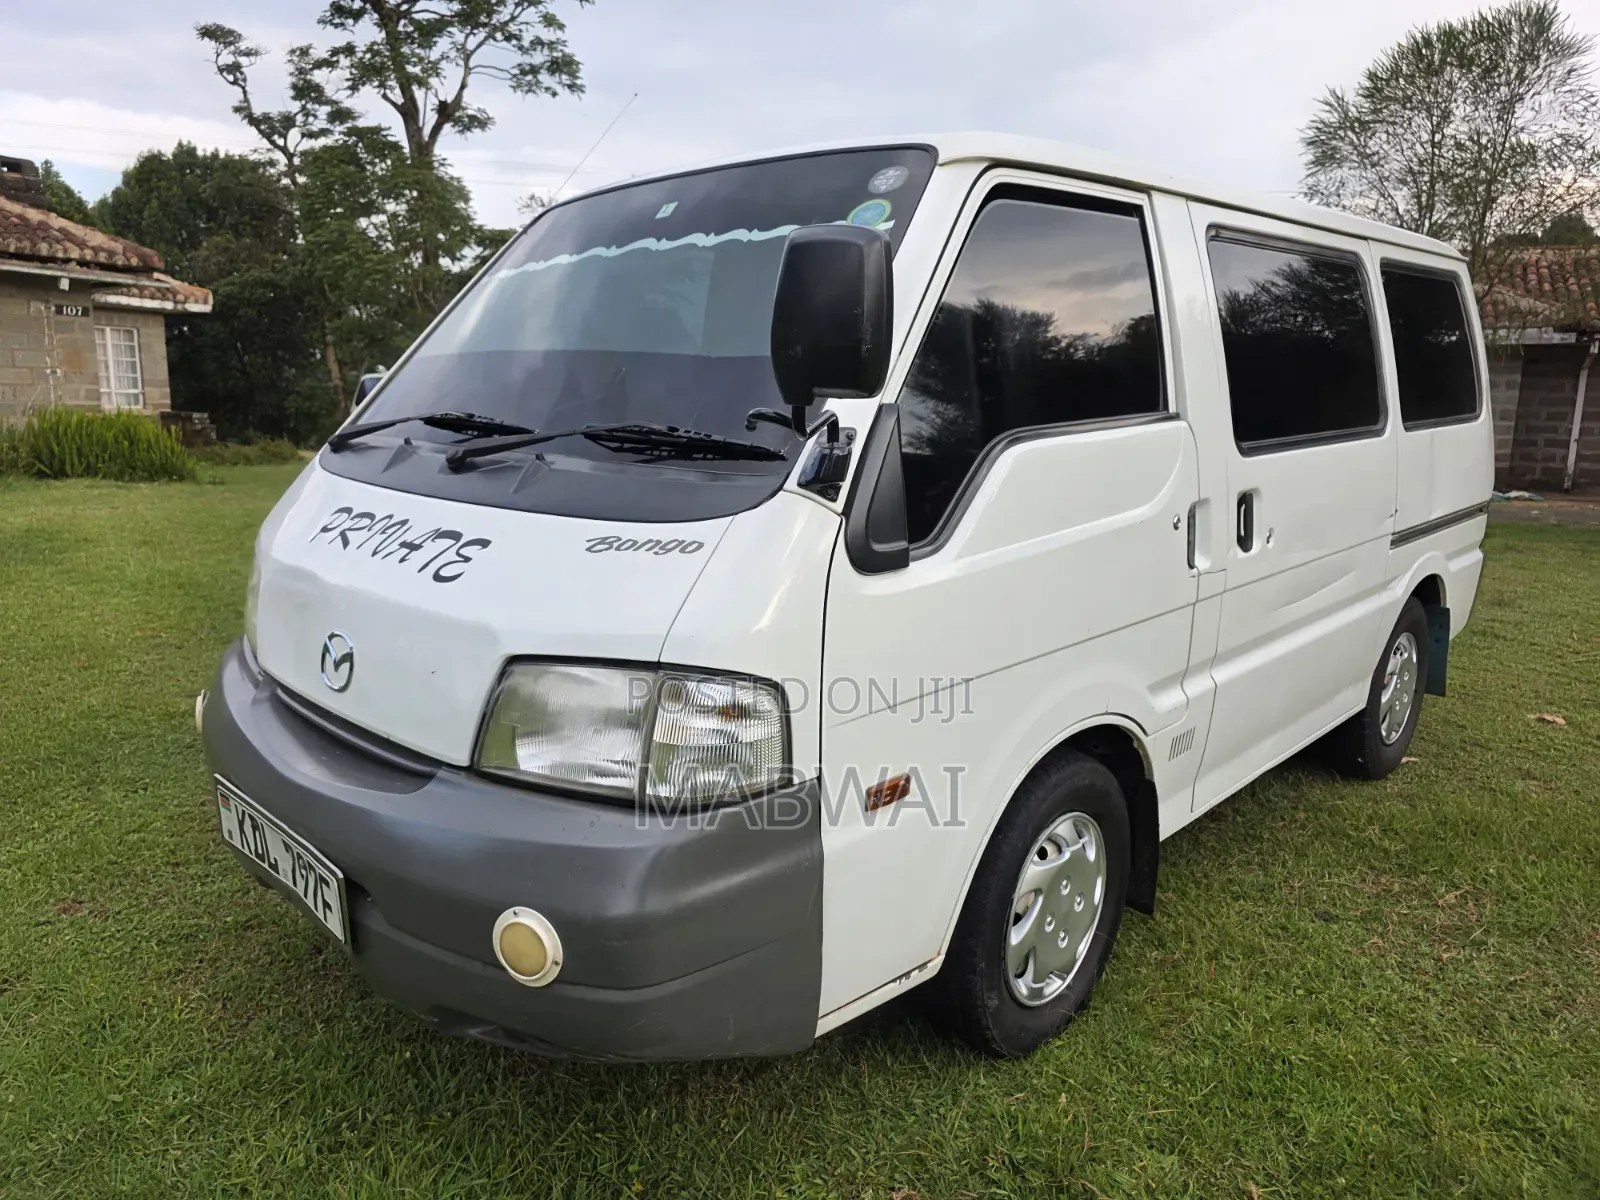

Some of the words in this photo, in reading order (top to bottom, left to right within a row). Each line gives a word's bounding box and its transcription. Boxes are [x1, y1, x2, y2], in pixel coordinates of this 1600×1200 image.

[62, 305, 82, 316] 107
[309, 506, 492, 583] PRIVATE
[585, 536, 704, 555] Bongo
[234, 803, 280, 876] KDL
[281, 838, 332, 923] 797F
